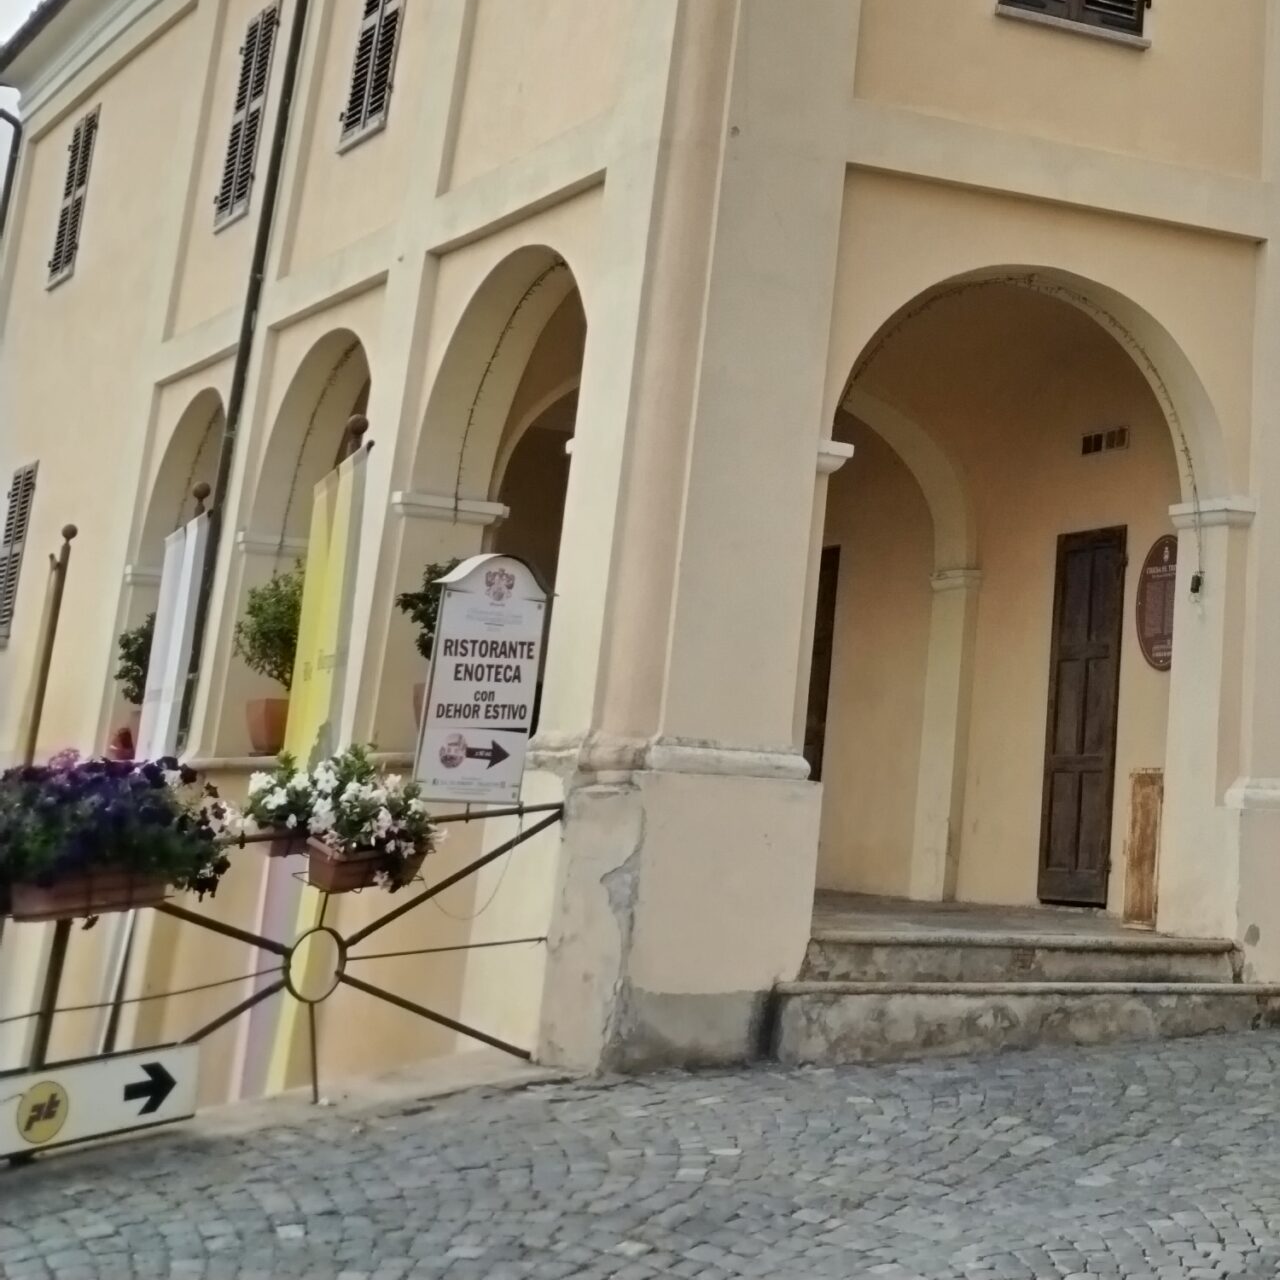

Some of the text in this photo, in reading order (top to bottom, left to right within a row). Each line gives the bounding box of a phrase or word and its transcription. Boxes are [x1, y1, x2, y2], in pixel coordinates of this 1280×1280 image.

[443, 638, 535, 660] RISTORANTE
[453, 663, 522, 683] ENOTECA
[474, 690, 495, 702] con
[436, 703, 527, 720] DEHOR ESTIVO
